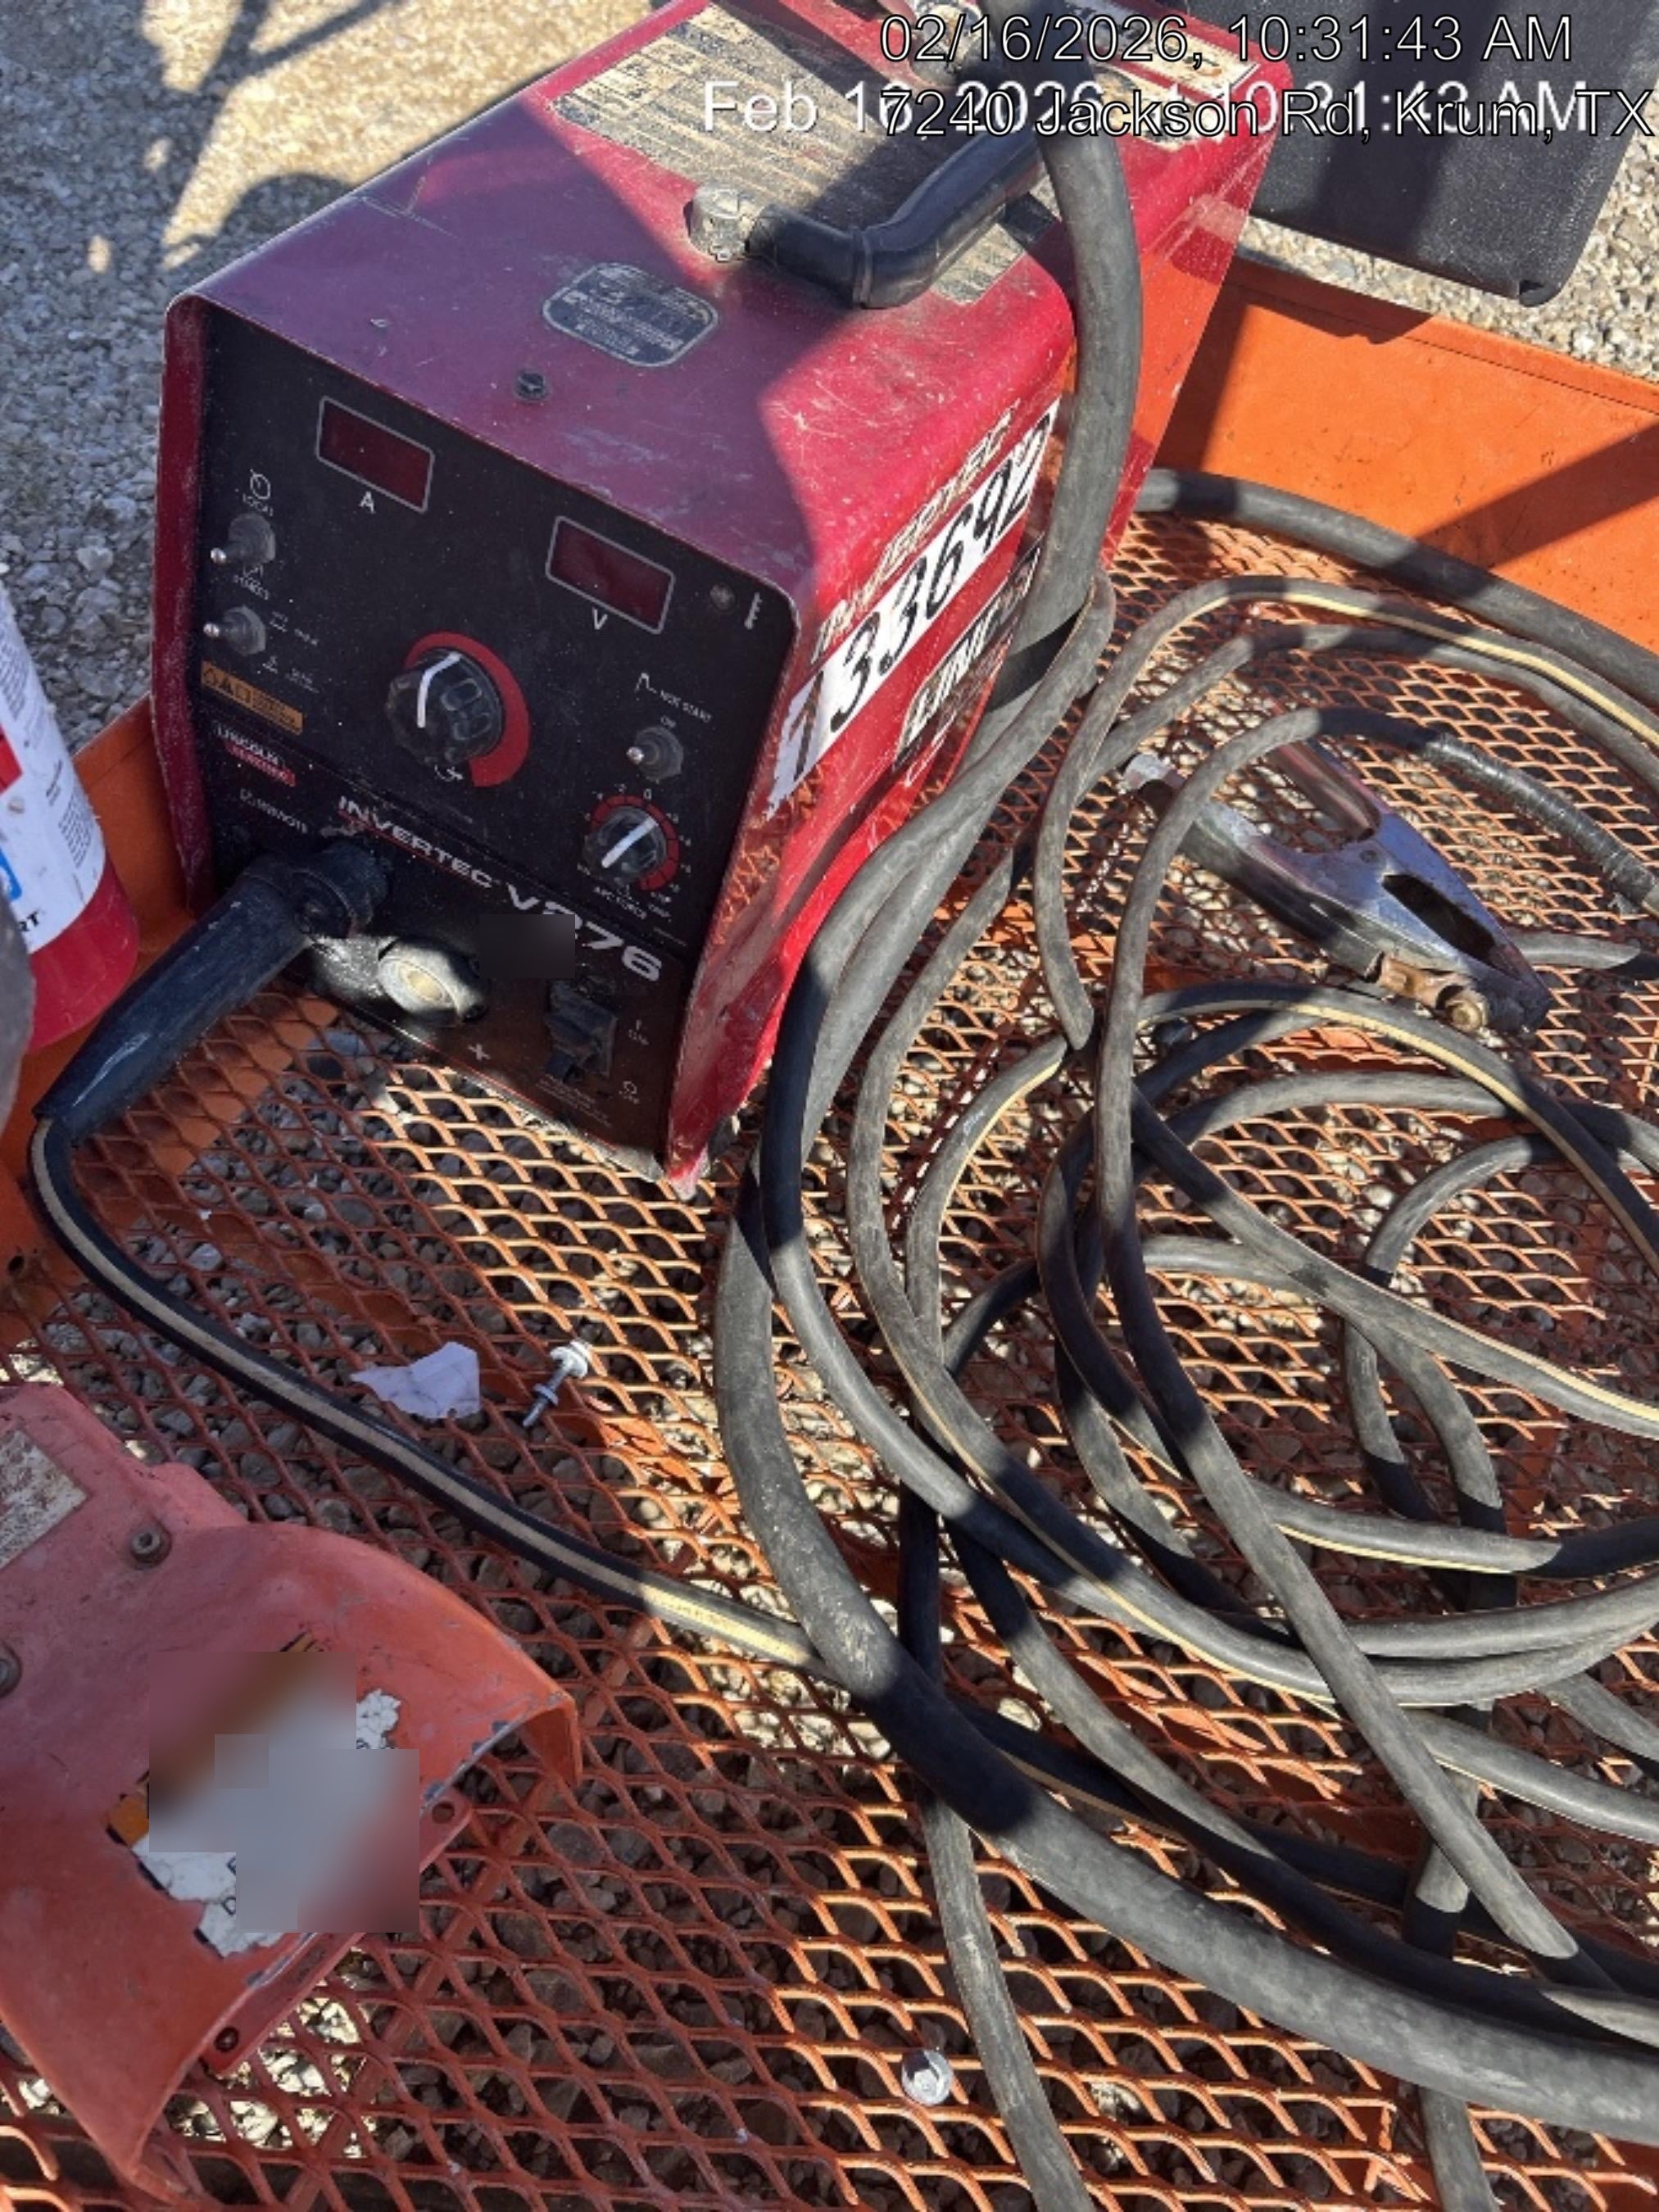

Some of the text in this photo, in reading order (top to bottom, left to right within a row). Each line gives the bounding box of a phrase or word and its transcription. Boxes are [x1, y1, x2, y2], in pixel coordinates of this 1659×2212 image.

[359, 491, 376, 514] A
[592, 607, 608, 630] V
[338, 795, 492, 889] INVERTEC
